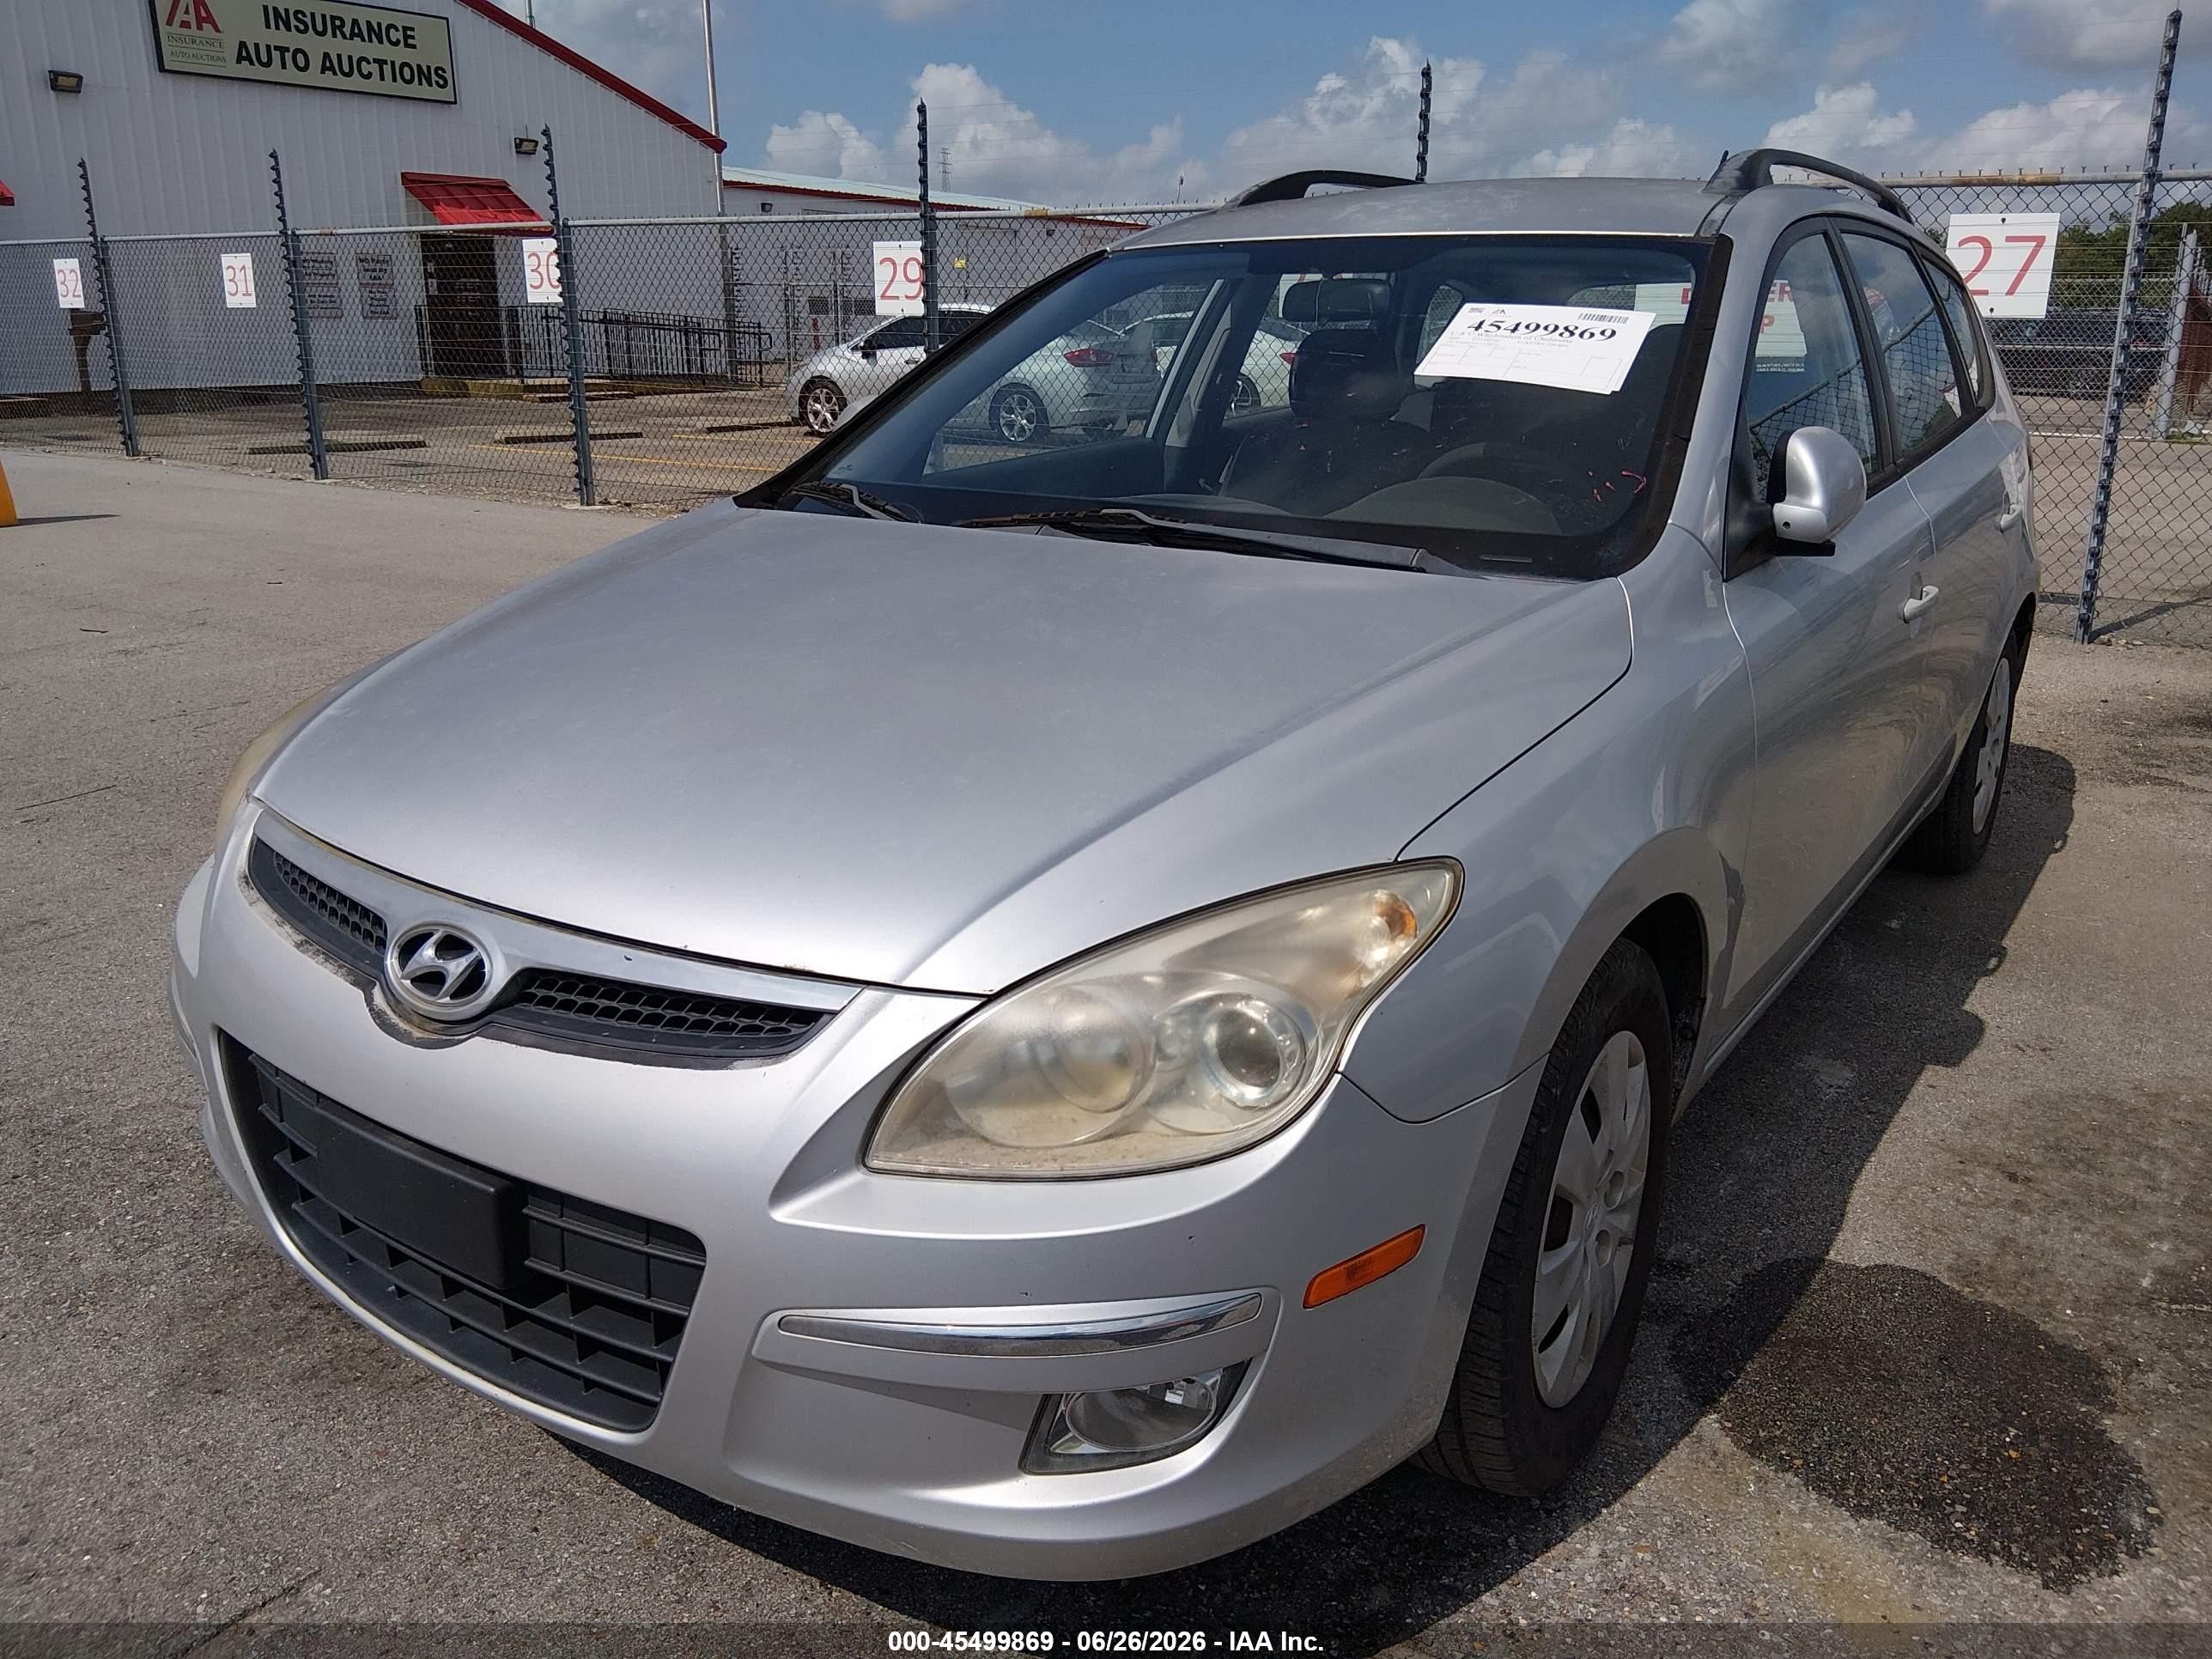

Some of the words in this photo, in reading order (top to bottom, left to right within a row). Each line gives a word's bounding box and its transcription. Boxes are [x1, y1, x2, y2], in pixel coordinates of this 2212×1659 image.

[167, 35, 225, 49] INSURANCE
[262, 4, 418, 50] INSURANCE
[170, 50, 190, 58] AUTO
[191, 52, 227, 63] AUCTIONS
[235, 40, 310, 72] AUTO
[320, 52, 449, 89] AUCTIONS
[226, 264, 252, 297] 31
[879, 257, 924, 301] 29
[1958, 235, 2046, 296] 27
[58, 269, 82, 298] 32
[1468, 319, 1617, 342] 45499869
